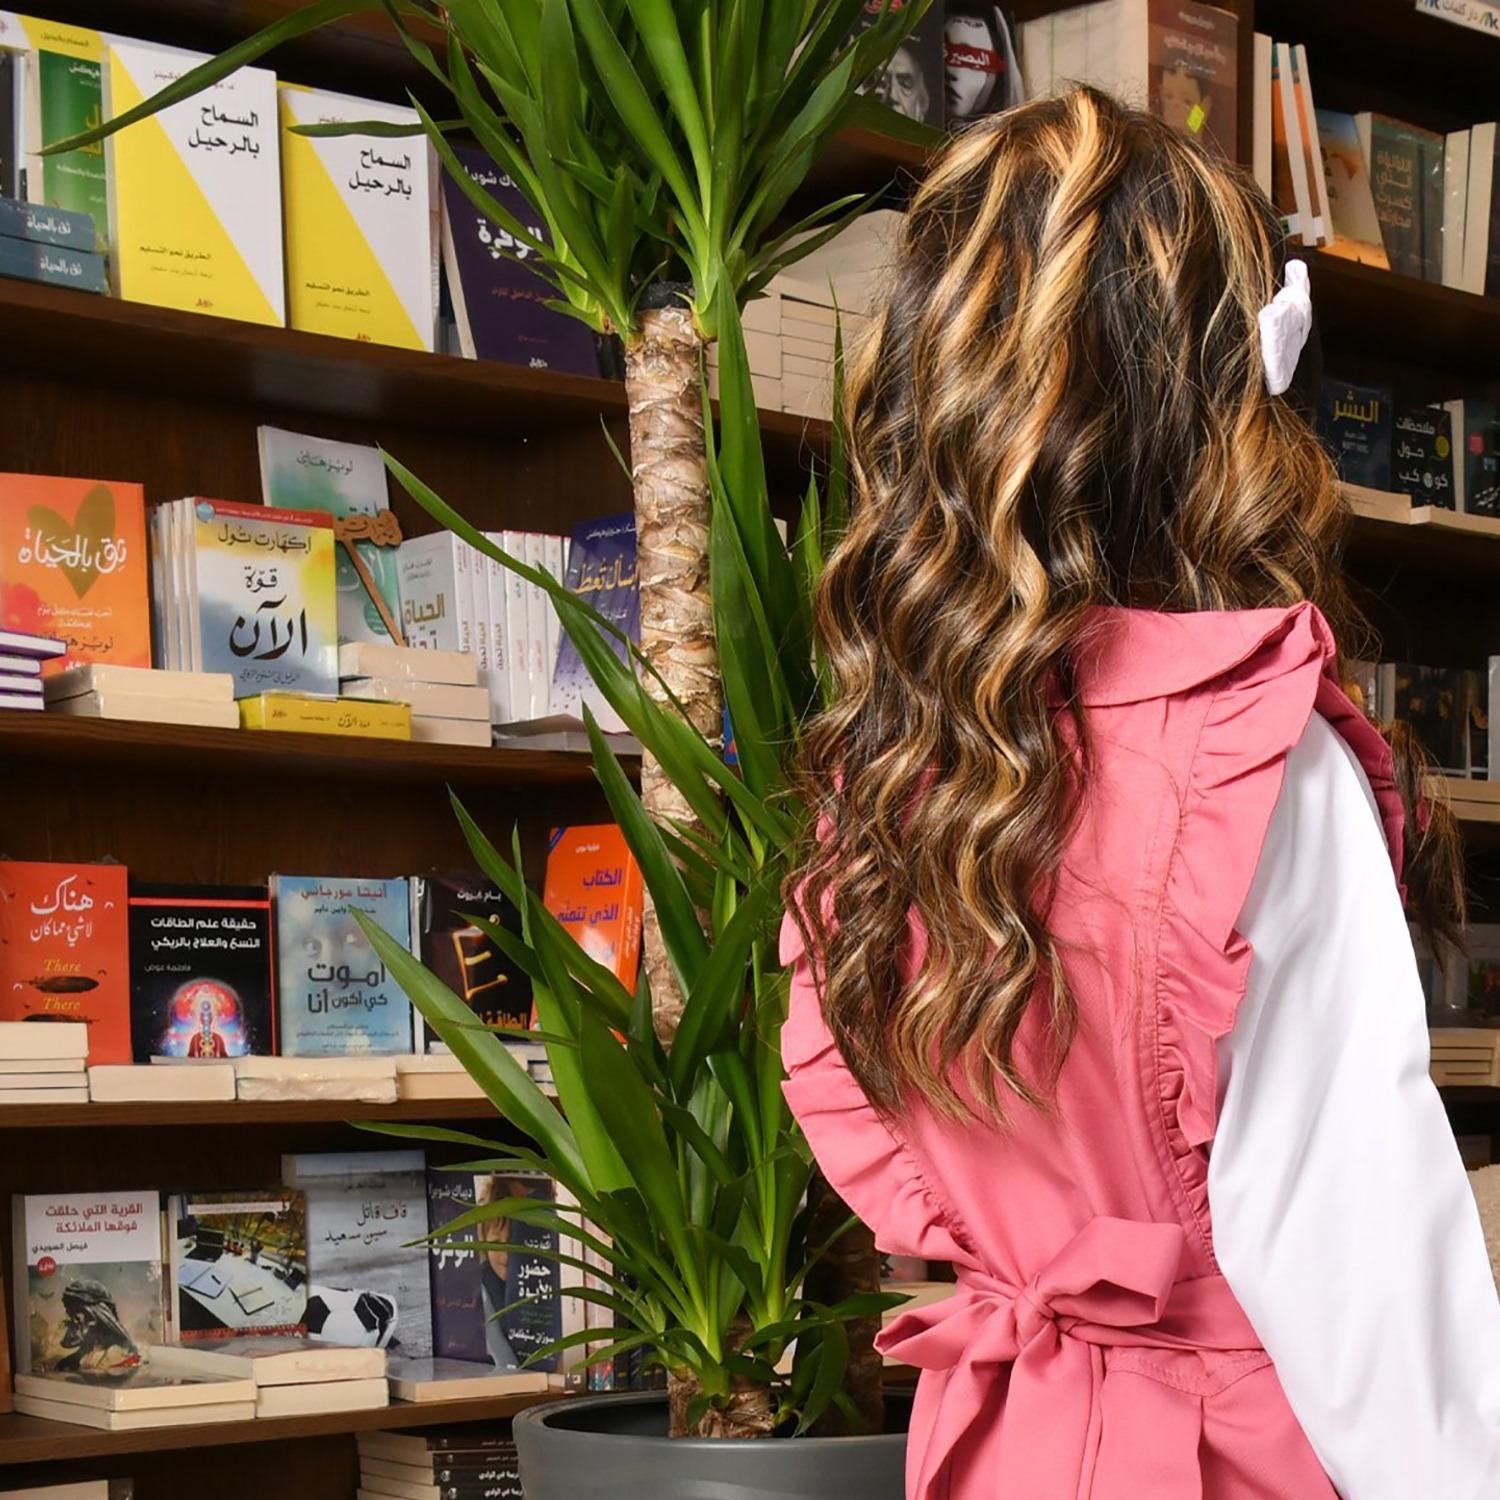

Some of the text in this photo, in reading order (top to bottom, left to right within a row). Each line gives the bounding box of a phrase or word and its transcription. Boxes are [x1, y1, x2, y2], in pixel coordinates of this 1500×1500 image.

[201, 104, 259, 128] السماح
[188, 129, 260, 159] بالرحيل
[359, 148, 412, 171] السماح
[348, 171, 412, 200] بالرحيل
[1332, 390, 1379, 428] البشر
[1395, 416, 1436, 436] ملاحظات
[1396, 441, 1425, 459] حول
[404, 592, 445, 630] الحياة
[229, 595, 308, 661] الآن
[583, 869, 622, 888] الكتاب
[31, 874, 94, 915] هناك
[589, 903, 619, 924] الذي
[150, 917, 257, 931] حقيقة علم الطاقات
[151, 935, 261, 951] التسع والعلاج بالريكي
[43, 958, 82, 974] There
[43, 996, 81, 1012] There
[364, 993, 389, 1013] كي
[45, 1202, 143, 1218] القرية التي حلقت
[55, 1220, 138, 1235] فوقها الملائكة
[518, 1258, 557, 1280] حضور
